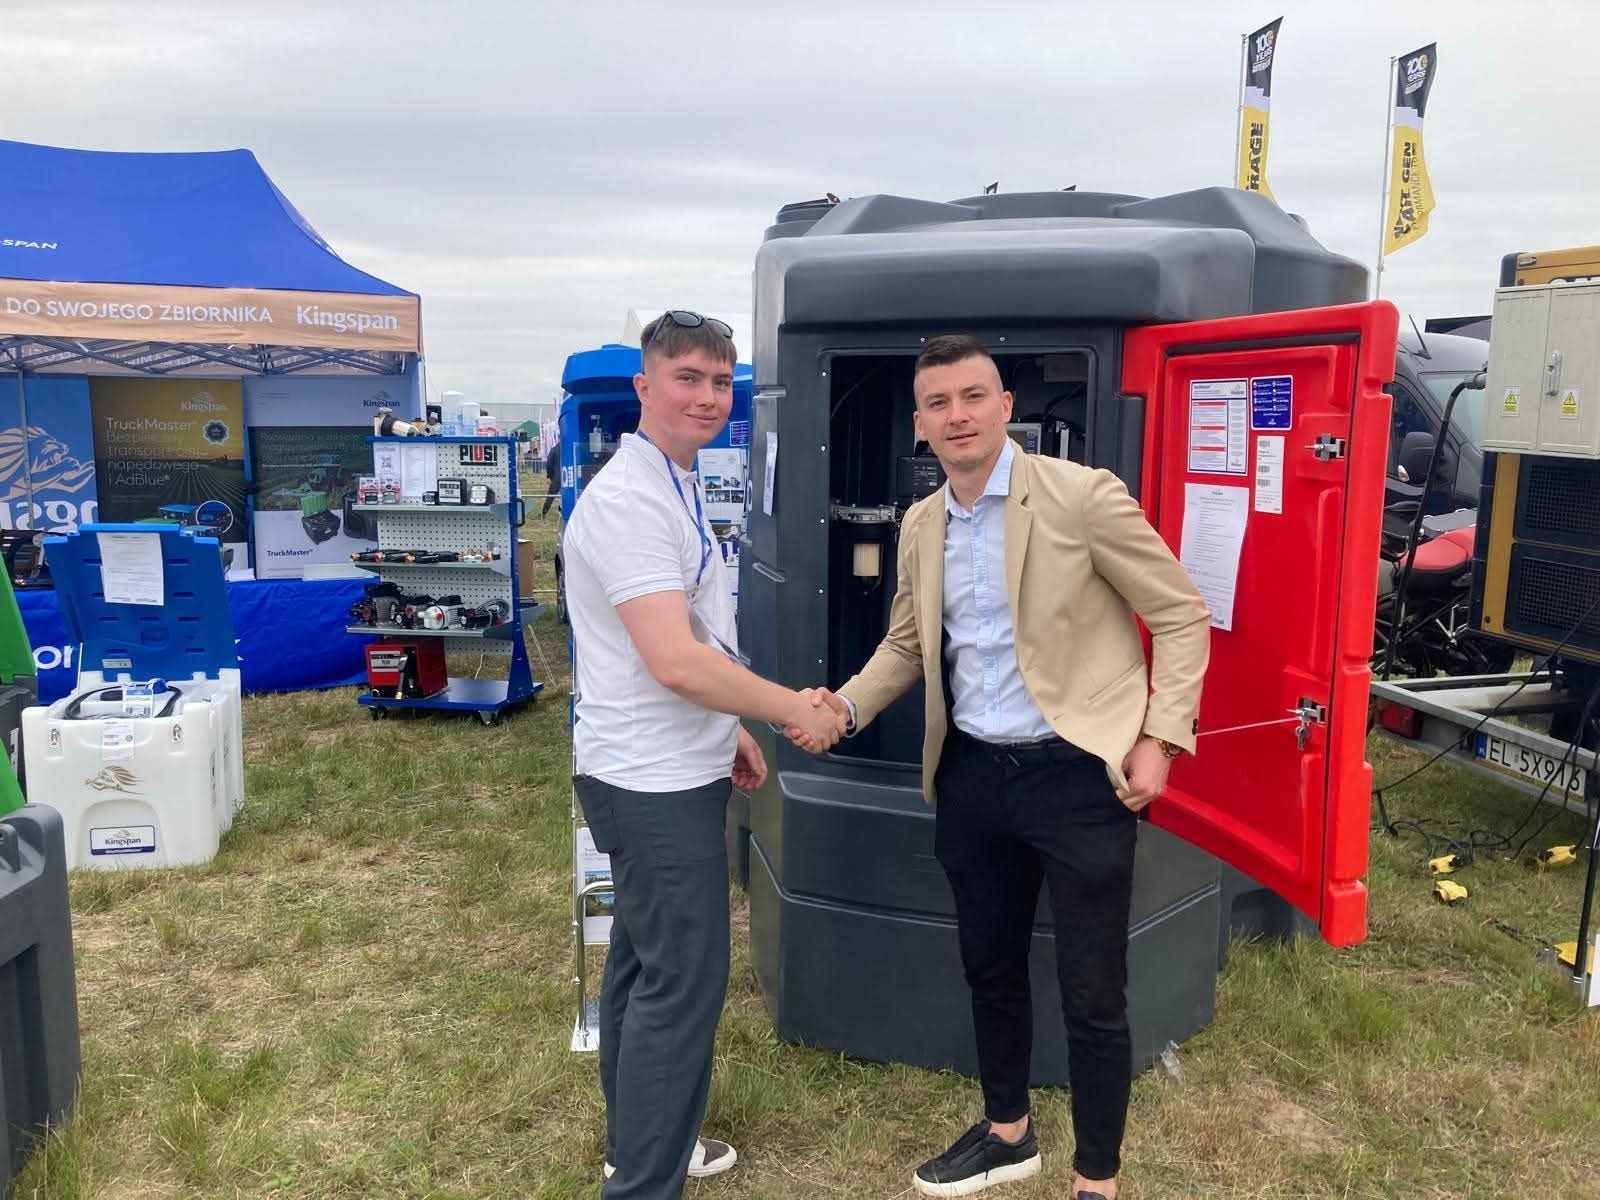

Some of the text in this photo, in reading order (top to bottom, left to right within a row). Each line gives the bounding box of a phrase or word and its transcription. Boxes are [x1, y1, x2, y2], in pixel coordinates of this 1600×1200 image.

[0, 239, 58, 250] SPAN
[6, 297, 398, 333] DO SWOJEGO ZBIORNIKA Kingspan
[180, 402, 228, 413] Kingspan
[363, 399, 400, 409] Kingspan
[460, 445, 497, 461] PIUSI
[1490, 739, 1511, 767] EL
[104, 837, 142, 849] Kingspan
